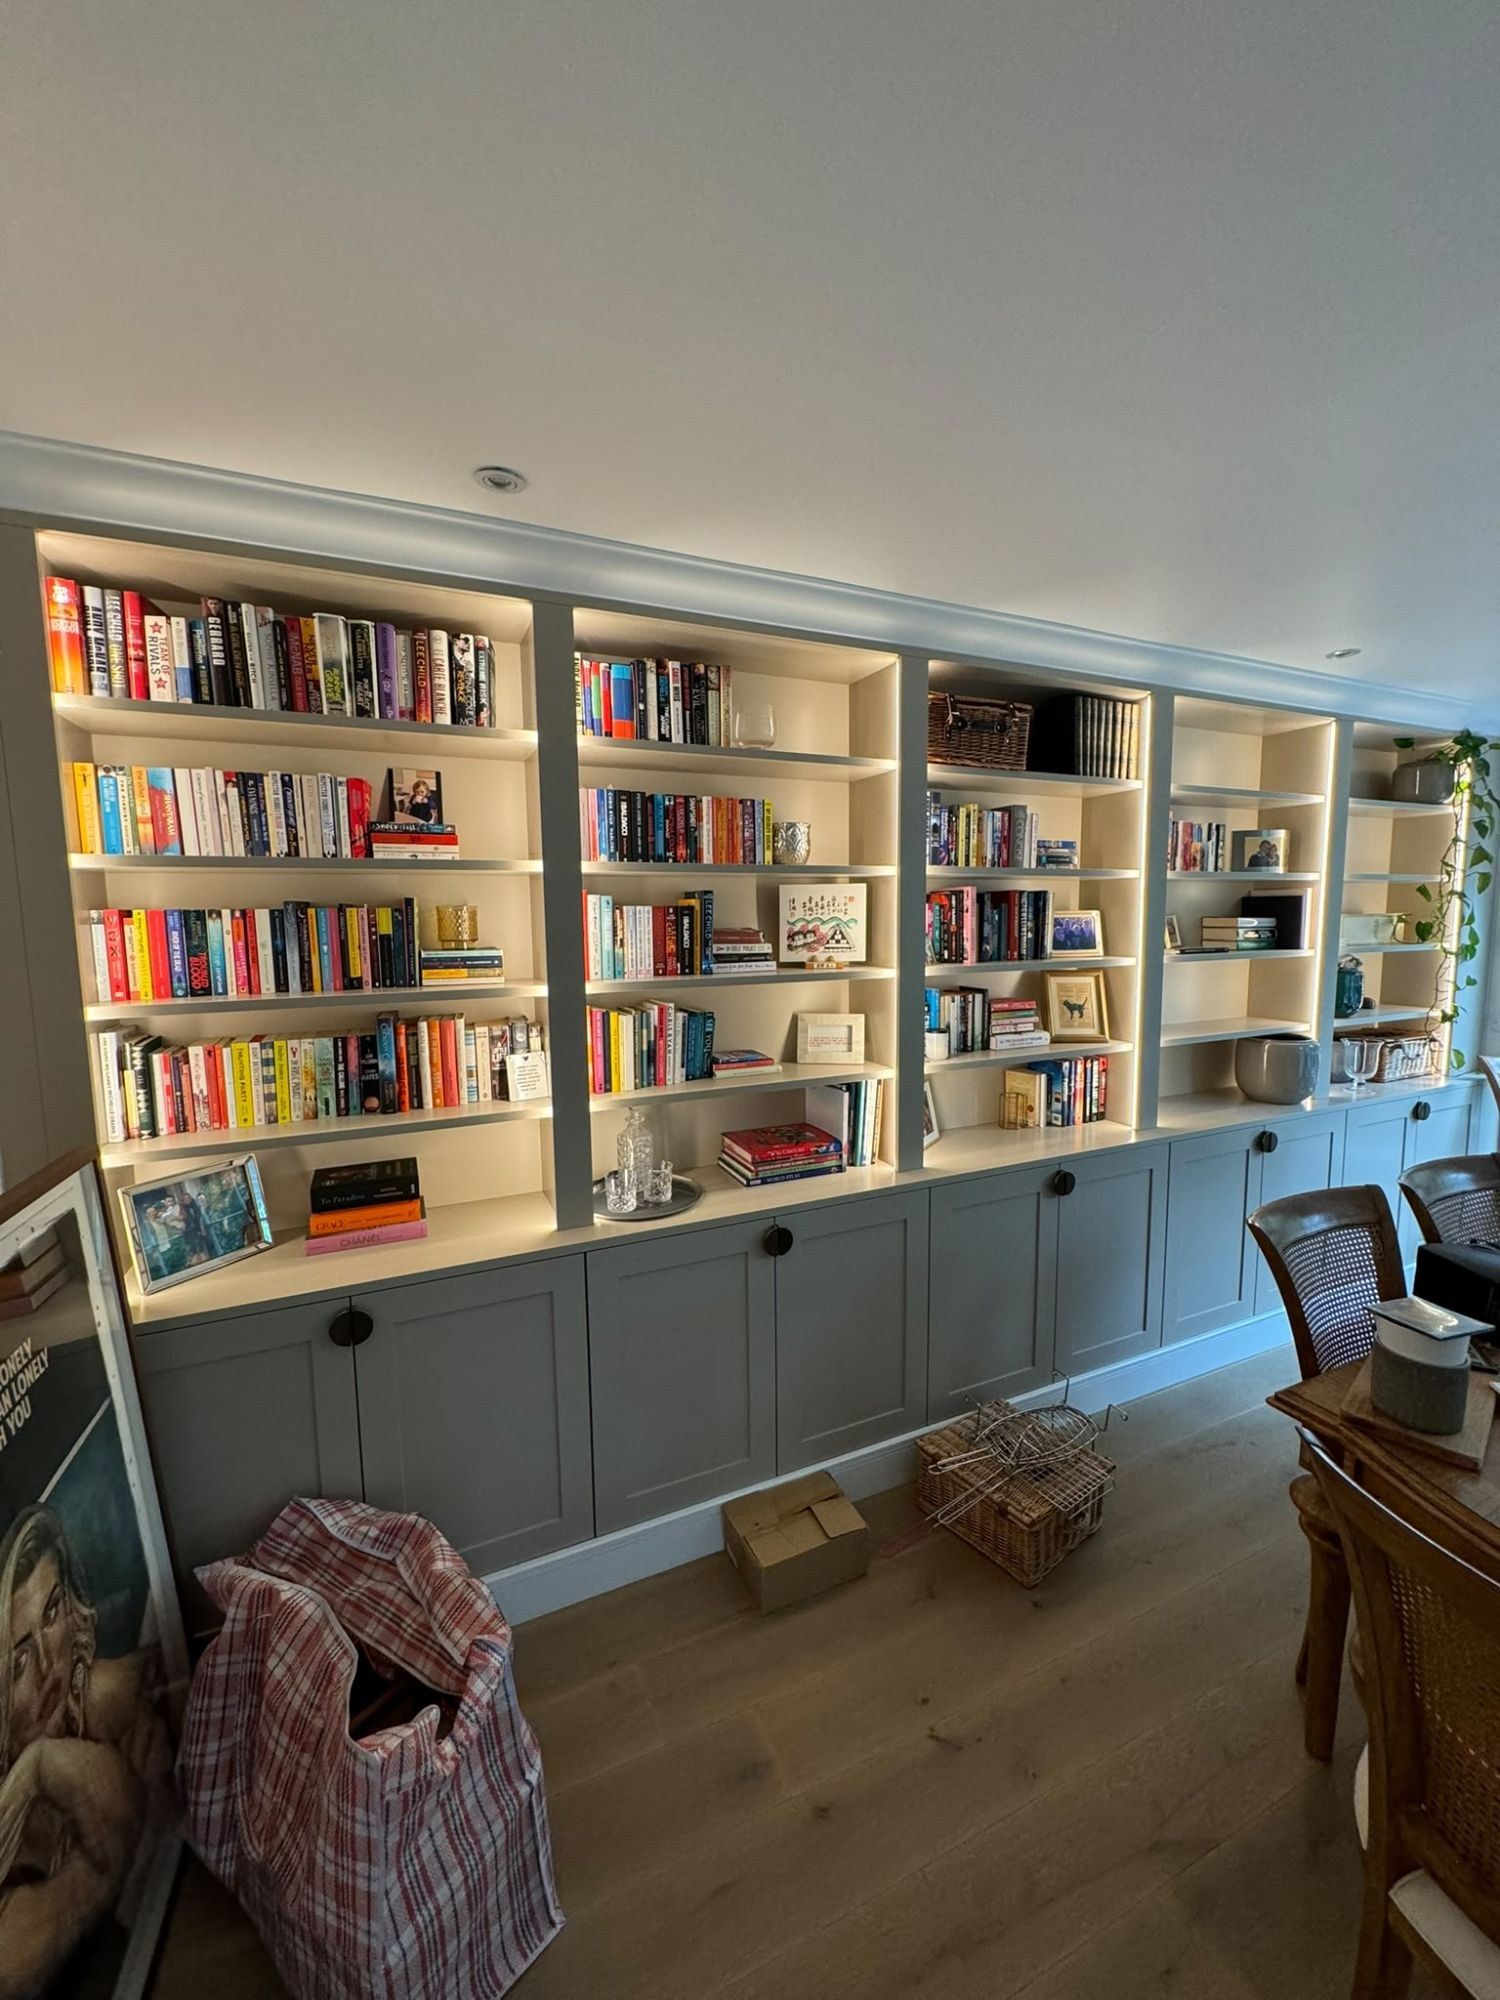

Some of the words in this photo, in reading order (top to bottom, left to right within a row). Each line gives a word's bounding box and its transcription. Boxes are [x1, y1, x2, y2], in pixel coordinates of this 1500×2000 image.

[106, 595, 120, 611] LEE
[106, 612, 123, 641] CHILD
[208, 616, 226, 666] GERRARD
[110, 643, 124, 664] ONE
[148, 636, 160, 675] RIVALS
[160, 637, 169, 662] TEAM
[231, 633, 242, 668] GOLDEN
[416, 641, 425, 658] LEE
[111, 664, 126, 688] SHOT
[161, 664, 170, 675] OF
[417, 658, 427, 688] CHILD
[324, 670, 334, 699] GRAVE
[457, 671, 466, 703] REVENGE
[164, 794, 176, 836] SHANTARAM
[191, 956, 201, 989] BLOOD
[704, 1034, 712, 1052] YOU
[240, 1082, 248, 1103] PARTY
[340, 1234, 382, 1247] CHANEL
[0, 1336, 32, 1390] ONELY
[11, 1346, 49, 1402] LONELY
[6, 1394, 32, 1436] YOU
